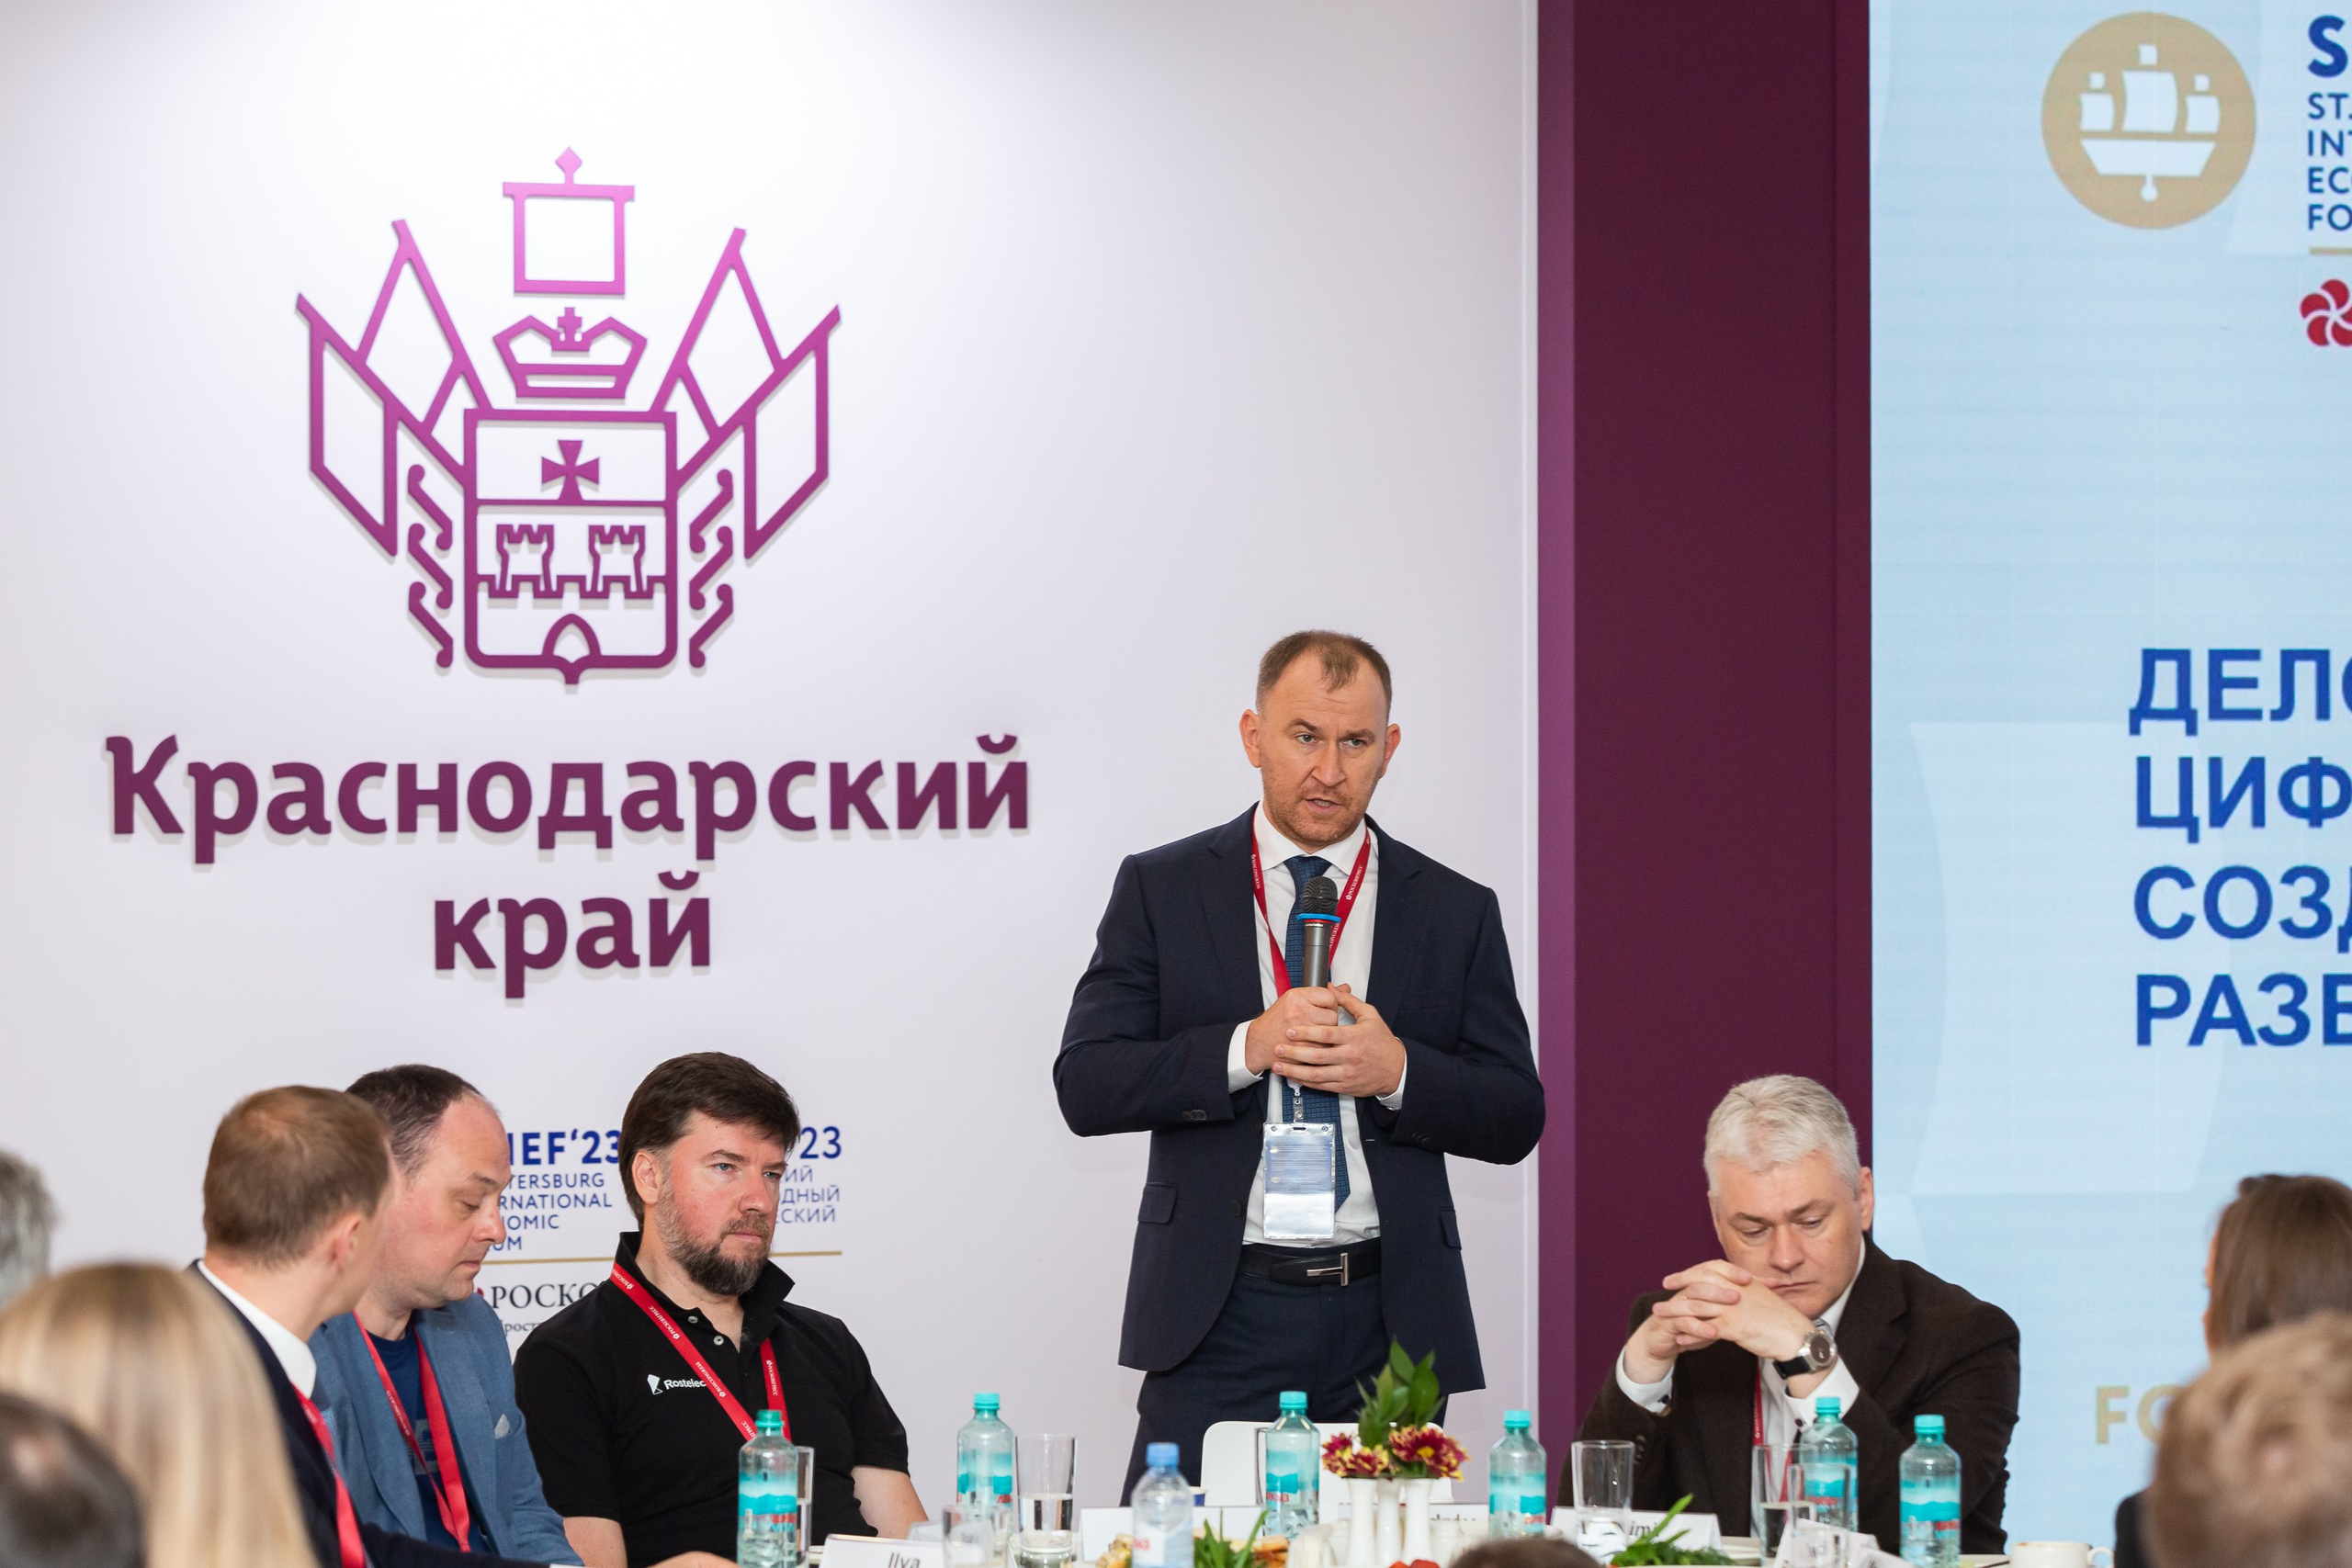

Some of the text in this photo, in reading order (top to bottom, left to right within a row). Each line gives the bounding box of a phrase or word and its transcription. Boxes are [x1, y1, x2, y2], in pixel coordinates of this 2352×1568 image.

[2307, 130, 2352, 157] IN
[2308, 166, 2352, 195] EC
[2128, 648, 2352, 737] ДЕЛ
[106, 734, 1028, 864] Краснодарский
[2136, 755, 2352, 844] ЦИФ
[435, 871, 711, 999] край
[2133, 864, 2352, 954] СОЗ
[776, 1204, 836, 1224] СКИЙ
[663, 1378, 707, 1390] Rostelec
